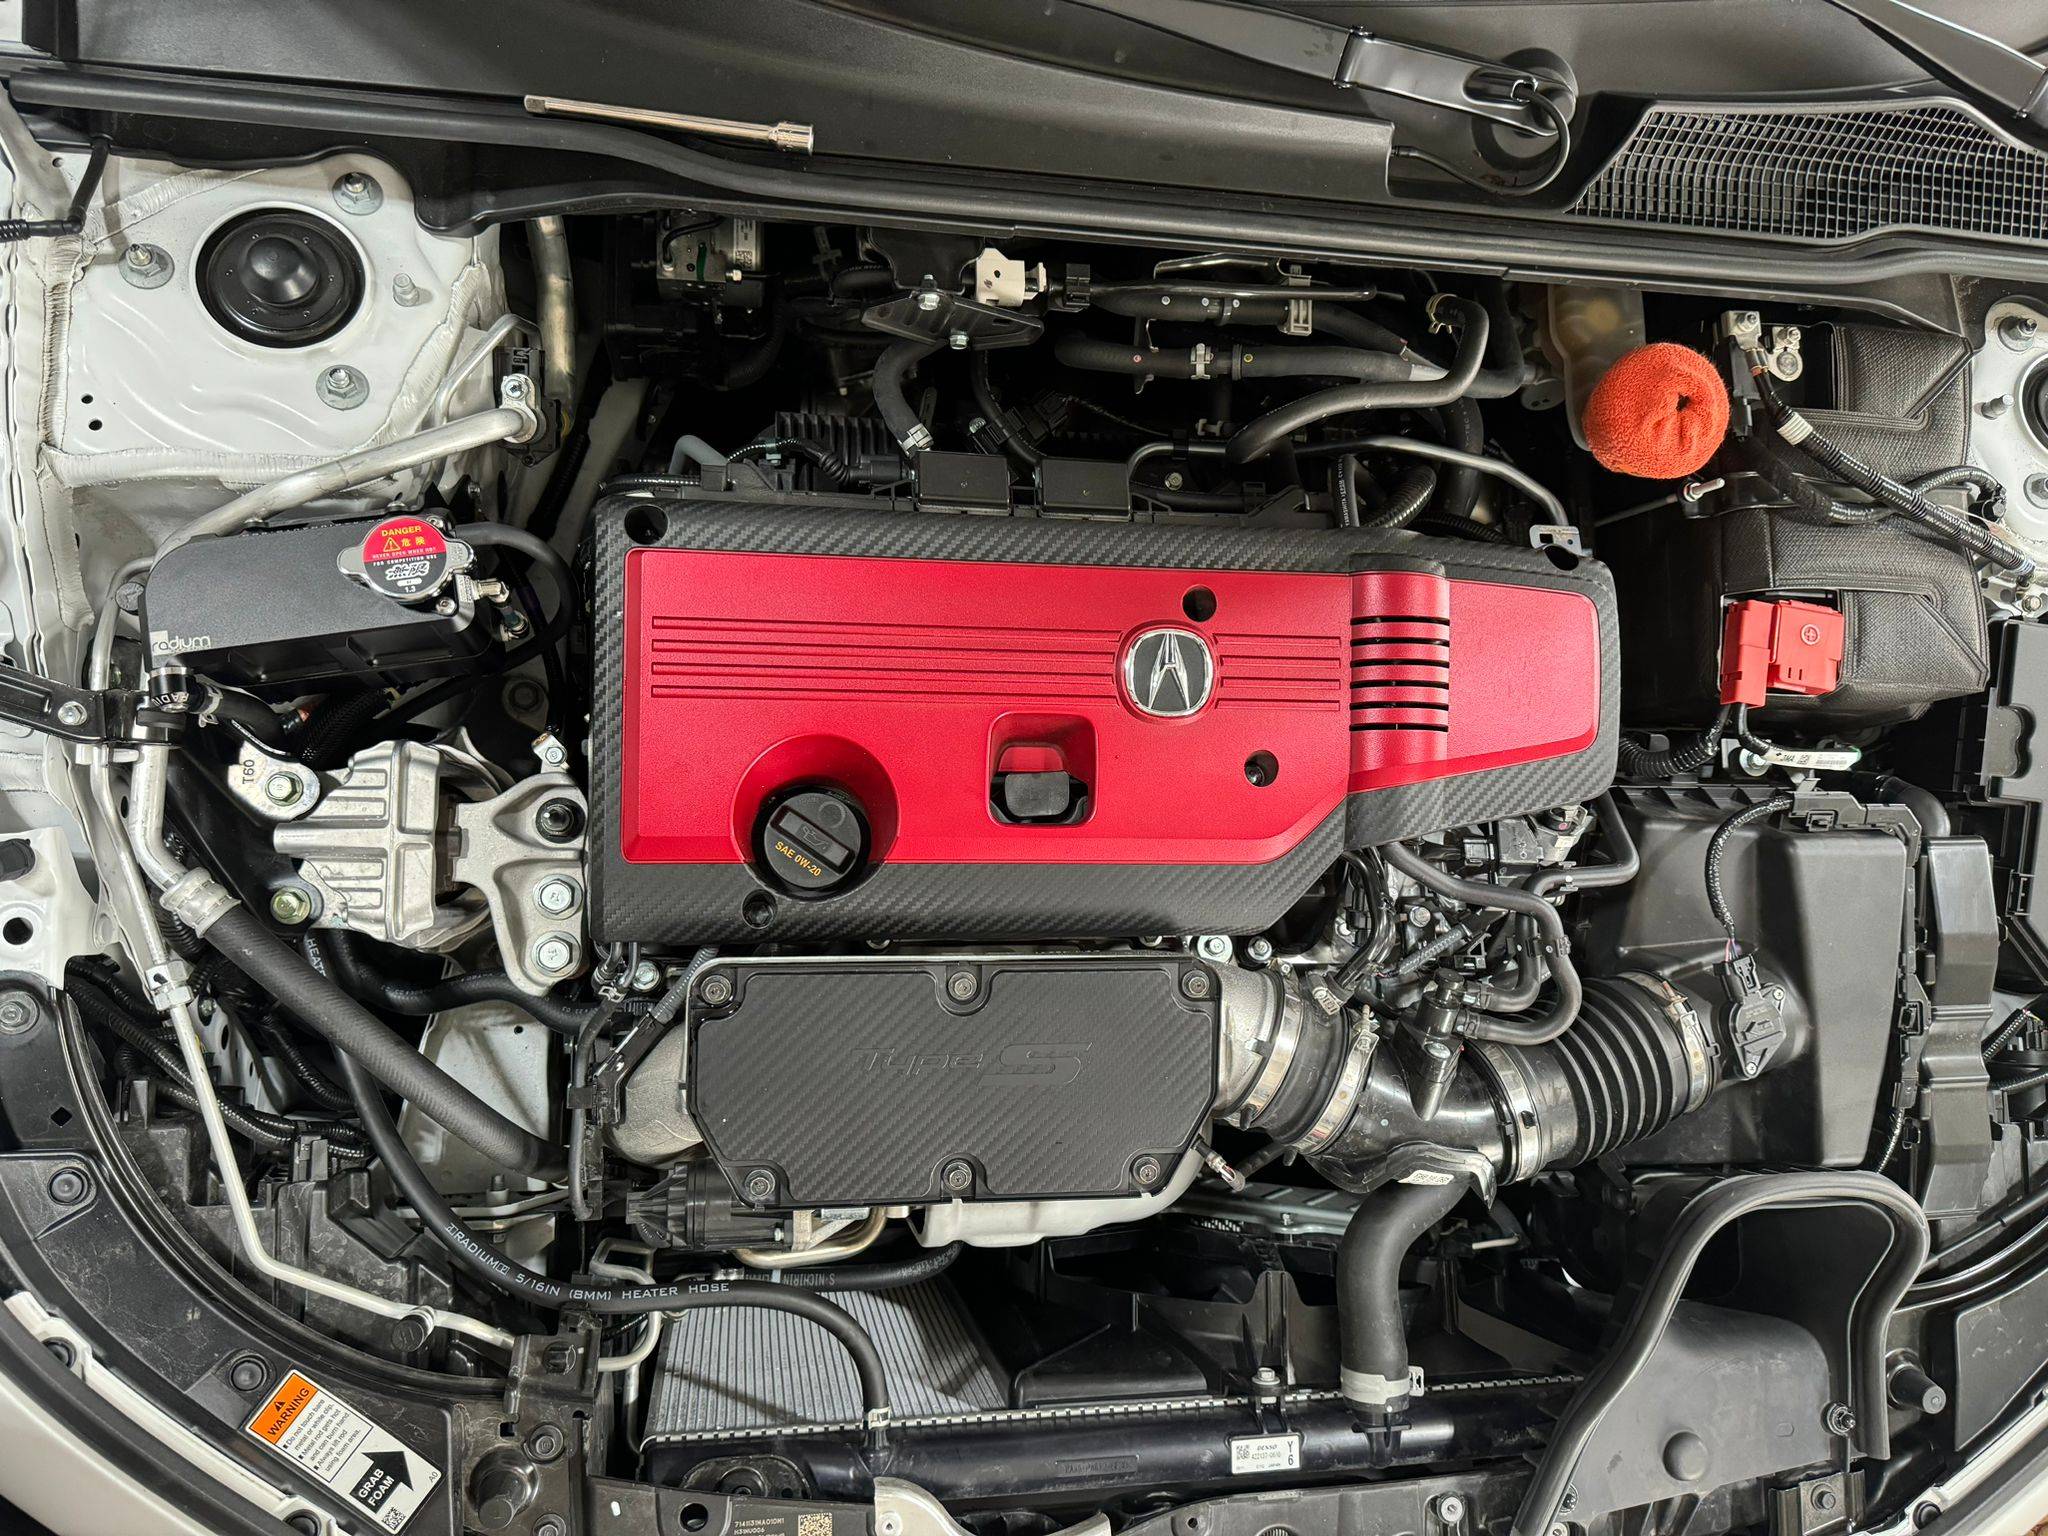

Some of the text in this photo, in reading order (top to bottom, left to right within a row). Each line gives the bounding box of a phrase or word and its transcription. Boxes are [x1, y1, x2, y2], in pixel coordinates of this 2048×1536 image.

[381, 525, 422, 537] DANGER
[372, 552, 390, 560] NEVER
[391, 550, 407, 558] OPEN
[407, 548, 424, 556] WHEN
[386, 556, 424, 565] COMPETITION
[152, 635, 212, 652] radium
[242, 759, 255, 785] T60
[774, 841, 822, 877] SAE 0W-20
[850, 1041, 1095, 1087] Type S
[453, 1228, 730, 1301] RADIUM 5/16IN (8MM) HEATER HOSE
[268, 1387, 310, 1437] WARNING
[301, 1411, 315, 1428] touch
[313, 1399, 325, 1413] bare
[295, 1434, 308, 1450] metal
[311, 1413, 325, 1429] white
[301, 1439, 316, 1456] Metal
[322, 1419, 333, 1432] gets
[310, 1449, 320, 1461] and
[326, 1426, 338, 1440] burn
[317, 1447, 335, 1466] Always
[325, 1456, 339, 1472] using
[336, 1443, 350, 1457] foam
[1287, 1440, 1293, 1453] Y
[1287, 1454, 1295, 1466] 6
[358, 1468, 385, 1498] GRAB
[367, 1476, 395, 1507] FOAM
[428, 1471, 439, 1484] A0
